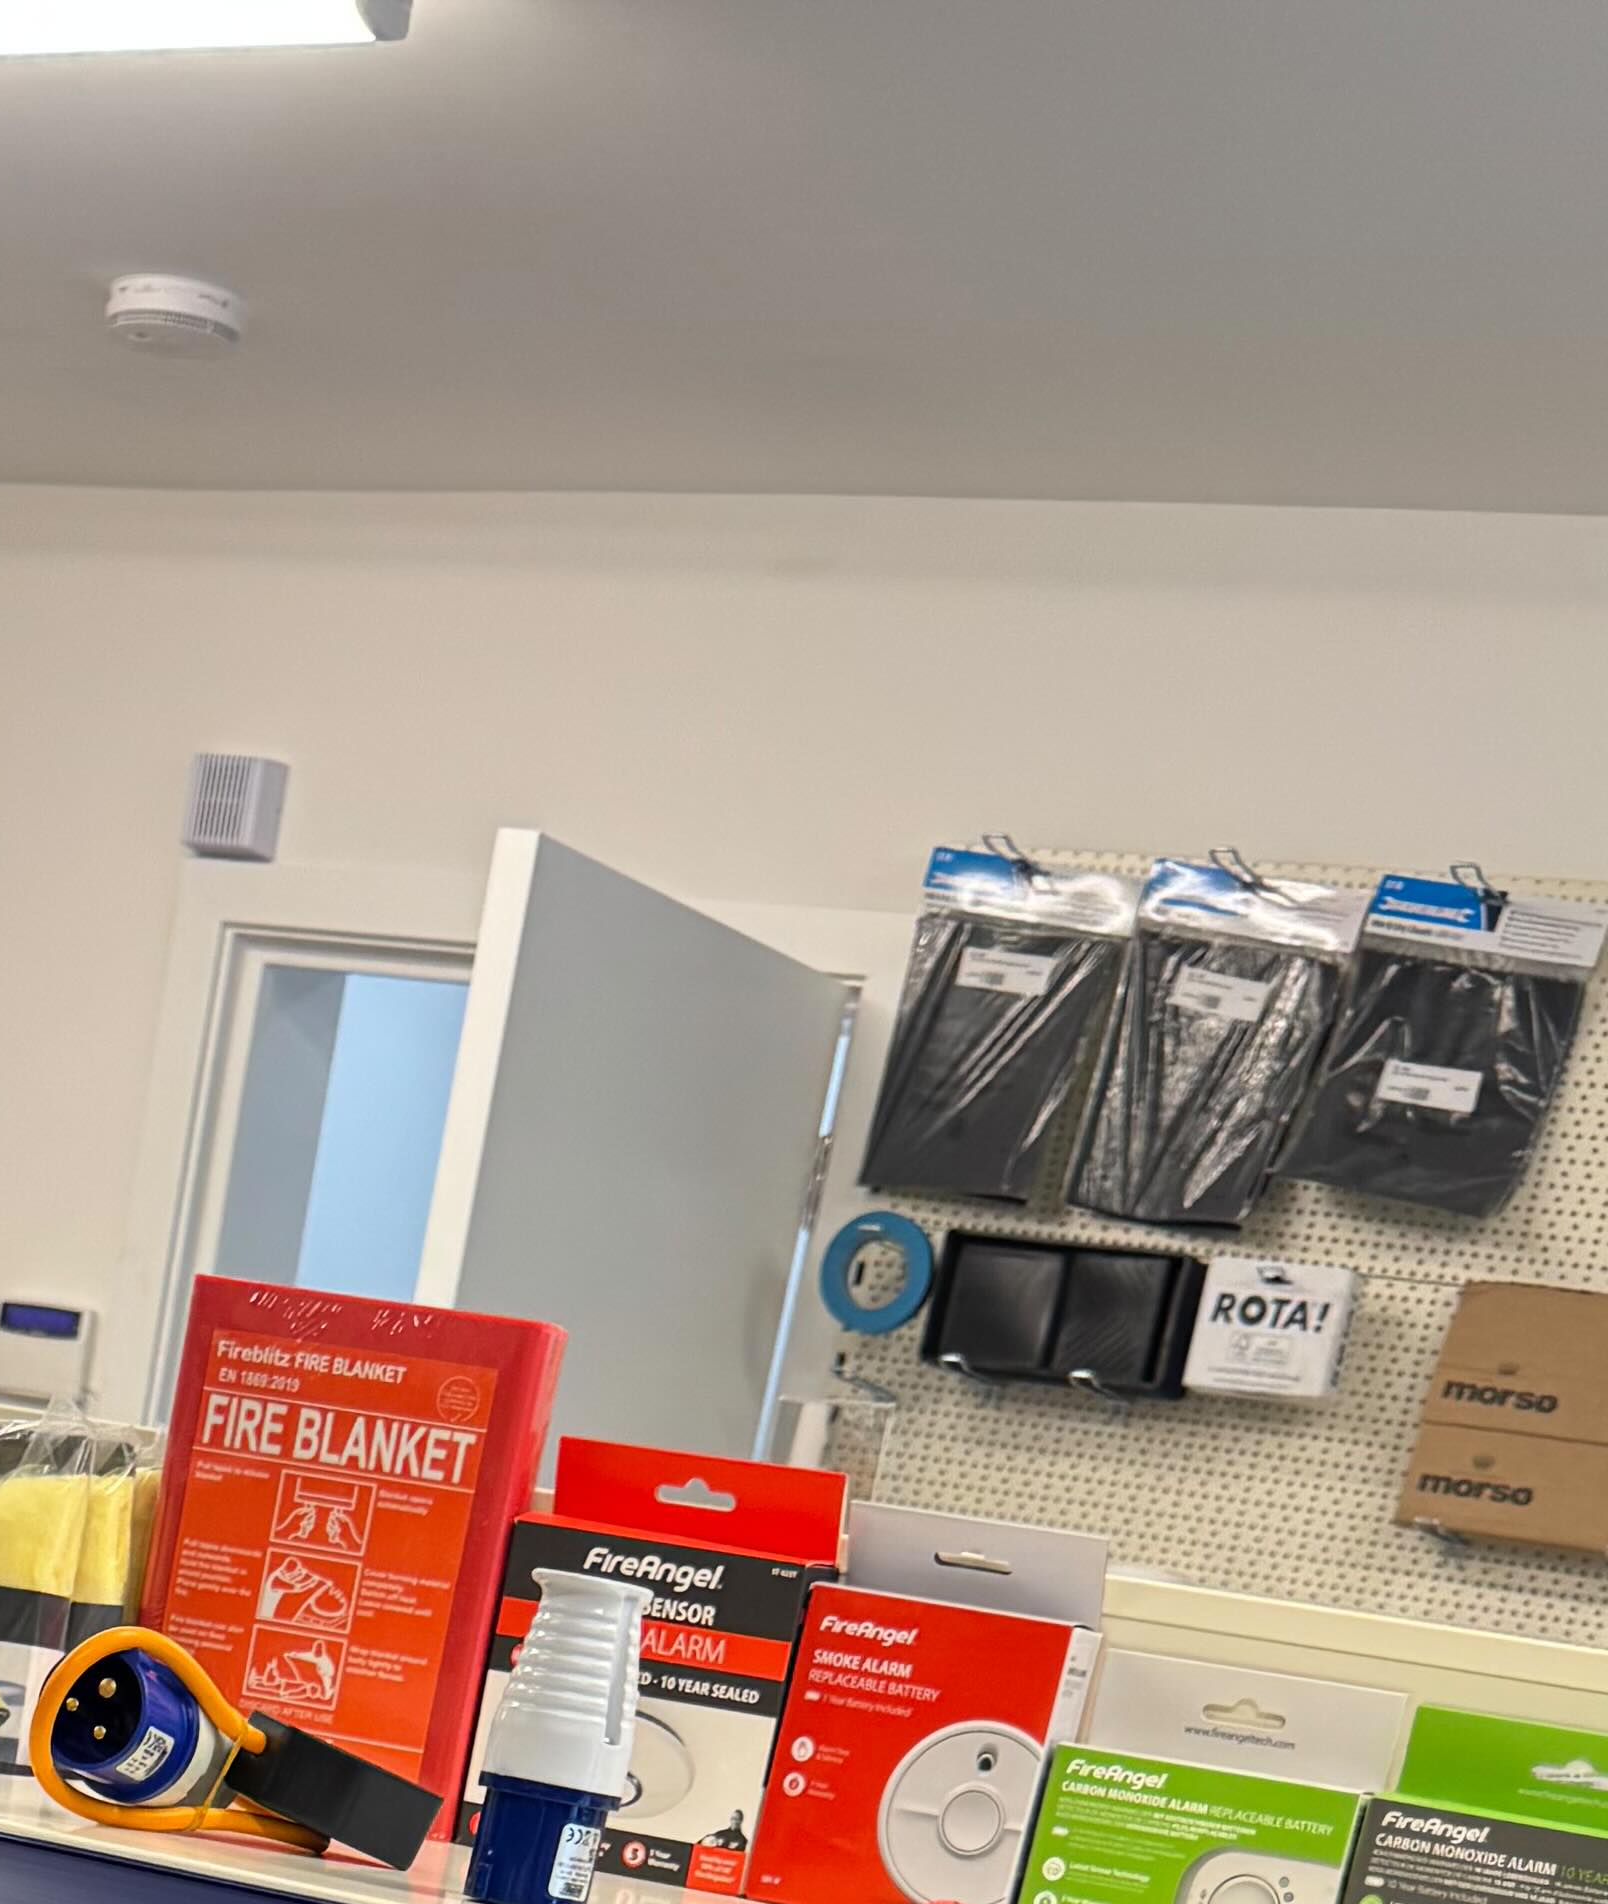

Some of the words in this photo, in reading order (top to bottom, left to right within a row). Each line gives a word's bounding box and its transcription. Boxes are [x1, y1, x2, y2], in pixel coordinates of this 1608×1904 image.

[1209, 1292, 1331, 1334] ROTA!
[217, 1341, 290, 1369] Fireblitz
[294, 1352, 330, 1376] FIRE
[332, 1359, 407, 1385] BLANKET
[219, 1367, 236, 1383] EN
[201, 1393, 288, 1455] FIRE
[293, 1406, 477, 1485] BLANKET
[583, 1547, 724, 1592] FireAngel
[642, 1628, 726, 1665] ALARM
[820, 1615, 919, 1647] FireAngel
[813, 1649, 860, 1672] SMOKE
[861, 1656, 912, 1679] ALARM
[660, 1676, 676, 1691] 10
[678, 1679, 710, 1697] YEAR
[711, 1685, 761, 1704] SEALED
[808, 1668, 887, 1695] REPLACEABLE
[887, 1682, 941, 1703] BATTERY
[1066, 1758, 1169, 1790] FireAngel
[1061, 1780, 1107, 1799] CARBON
[1107, 1788, 1167, 1809] MONOXIDE
[1168, 1797, 1209, 1815] ALARM
[1208, 1804, 1284, 1829] REPLACEABLE
[1284, 1817, 1334, 1836] BATTERY
[1381, 1811, 1491, 1843] FireAngel
[1375, 1833, 1431, 1853] CARBON
[1432, 1843, 1507, 1868] MONOXIDE
[1507, 1856, 1557, 1876] ALARM
